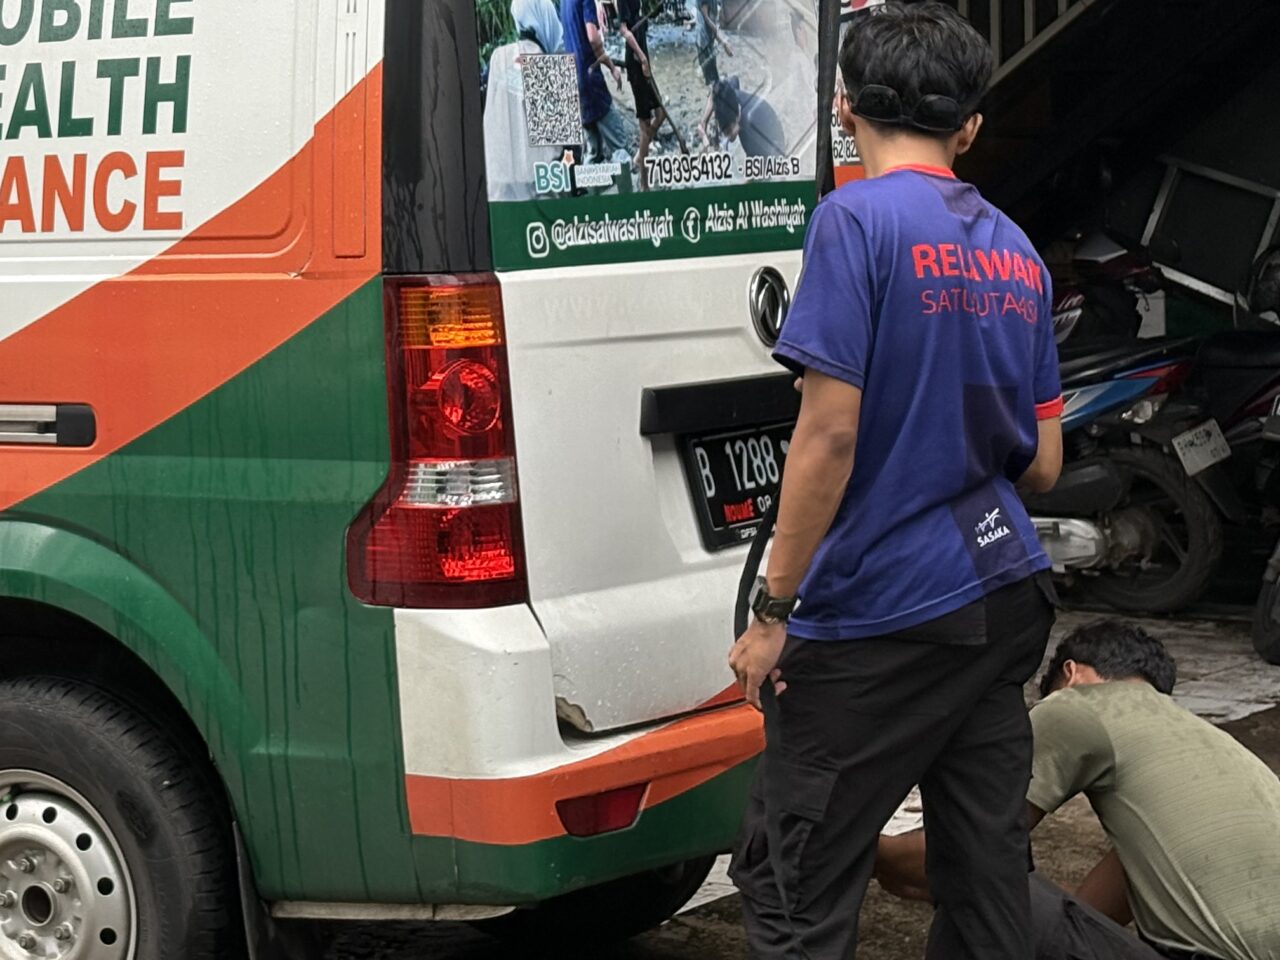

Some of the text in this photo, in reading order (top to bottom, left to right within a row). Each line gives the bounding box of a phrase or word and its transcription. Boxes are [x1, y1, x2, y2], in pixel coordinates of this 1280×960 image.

[535, 163, 570, 192] BSI
[645, 153, 732, 185] 7193954132
[745, 157, 763, 178] BSI
[551, 197, 806, 250] @alzisalwashliyah Alzis Al Washliyah
[695, 434, 780, 498] B 1288
[976, 525, 1010, 548] SASAKA
